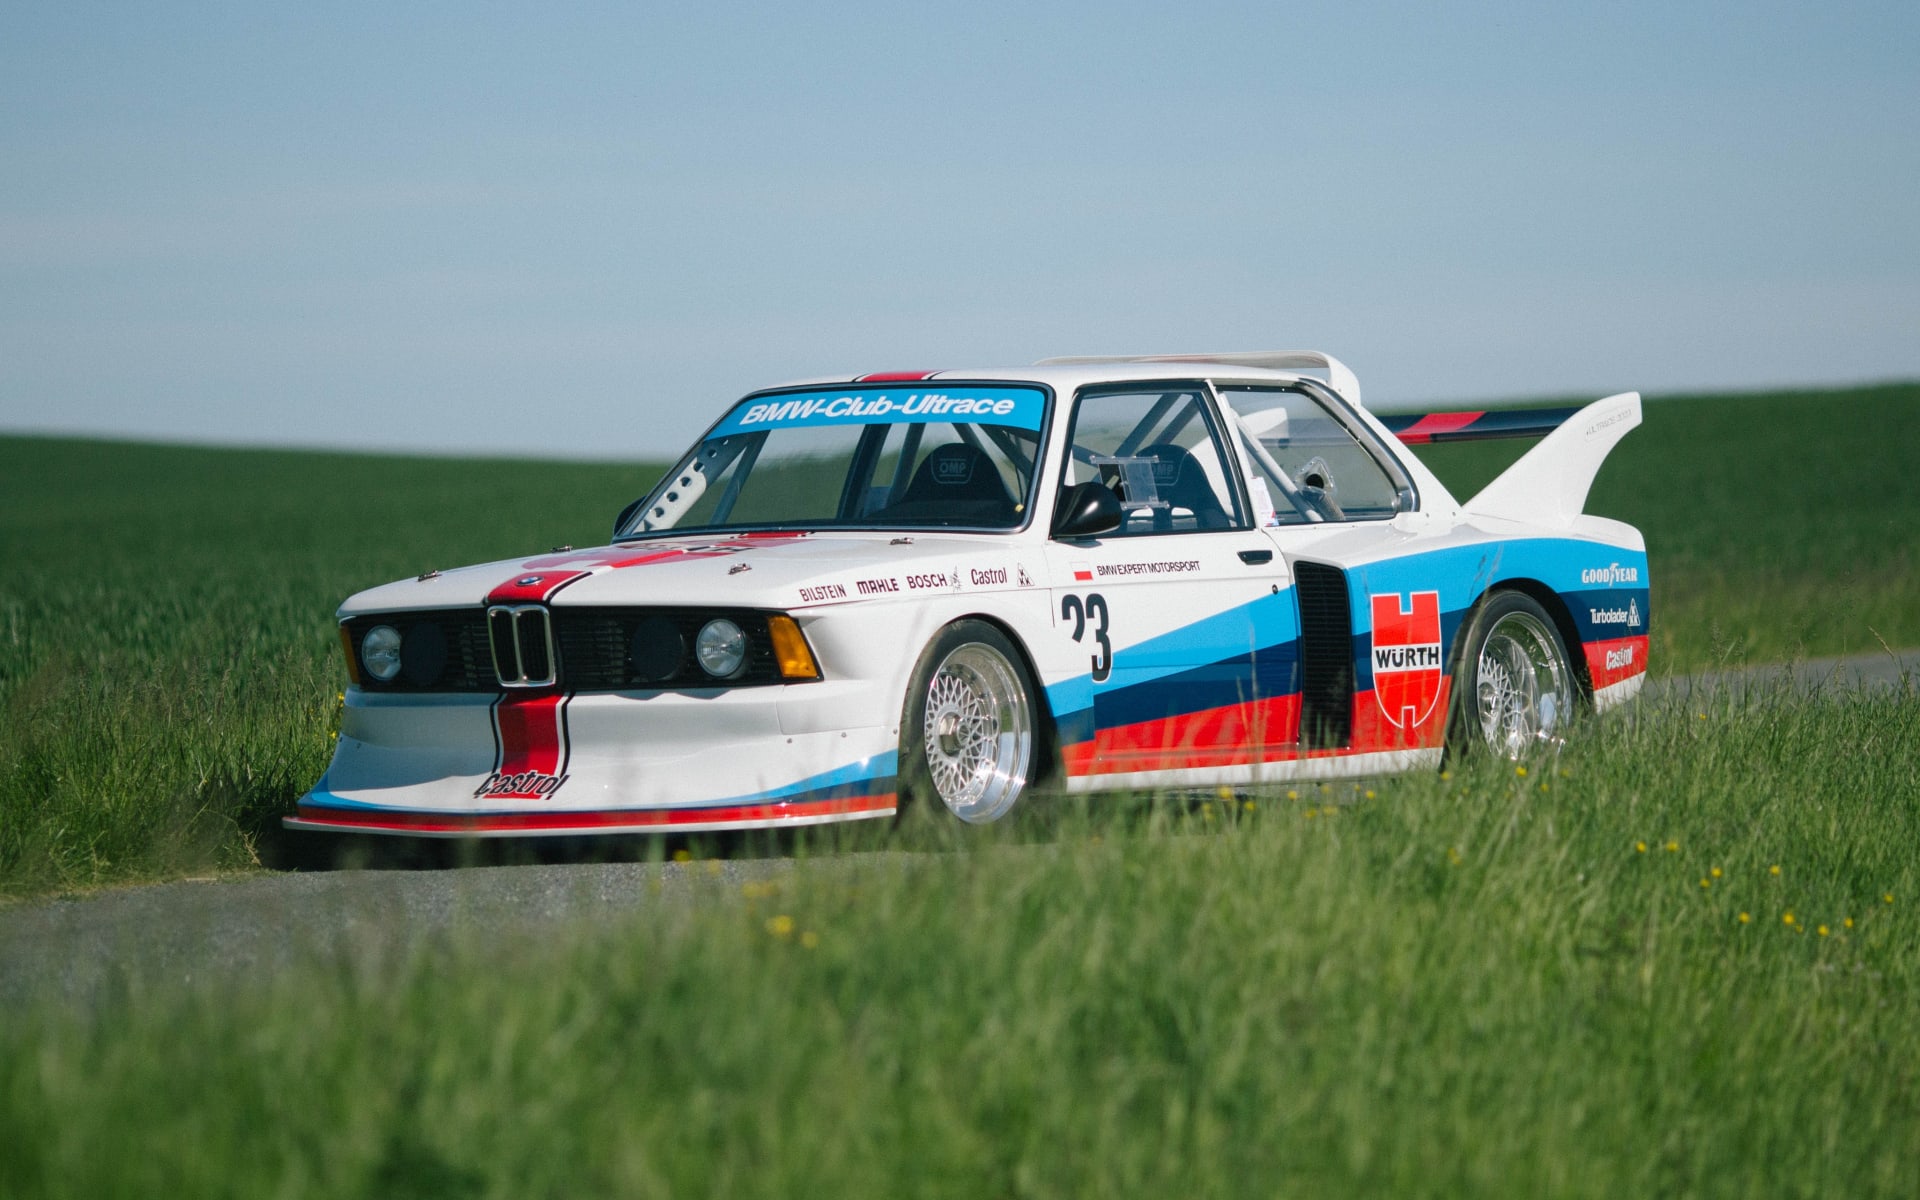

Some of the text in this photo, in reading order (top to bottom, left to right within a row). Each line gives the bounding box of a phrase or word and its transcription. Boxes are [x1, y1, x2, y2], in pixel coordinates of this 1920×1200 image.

[739, 394, 1014, 425] BMW-Club-Ultrace
[939, 462, 966, 473] OMP
[971, 567, 1007, 585] Castrol
[1097, 561, 1201, 576] BMW EXPERT MOTORSPORT
[1582, 565, 1638, 585] GOODYEAR
[799, 573, 948, 602] BILSTEIN MAHLE BOSCH
[1590, 608, 1628, 625] Turbolader
[1375, 646, 1440, 669] WÜRTH
[474, 771, 570, 796] Castrol
